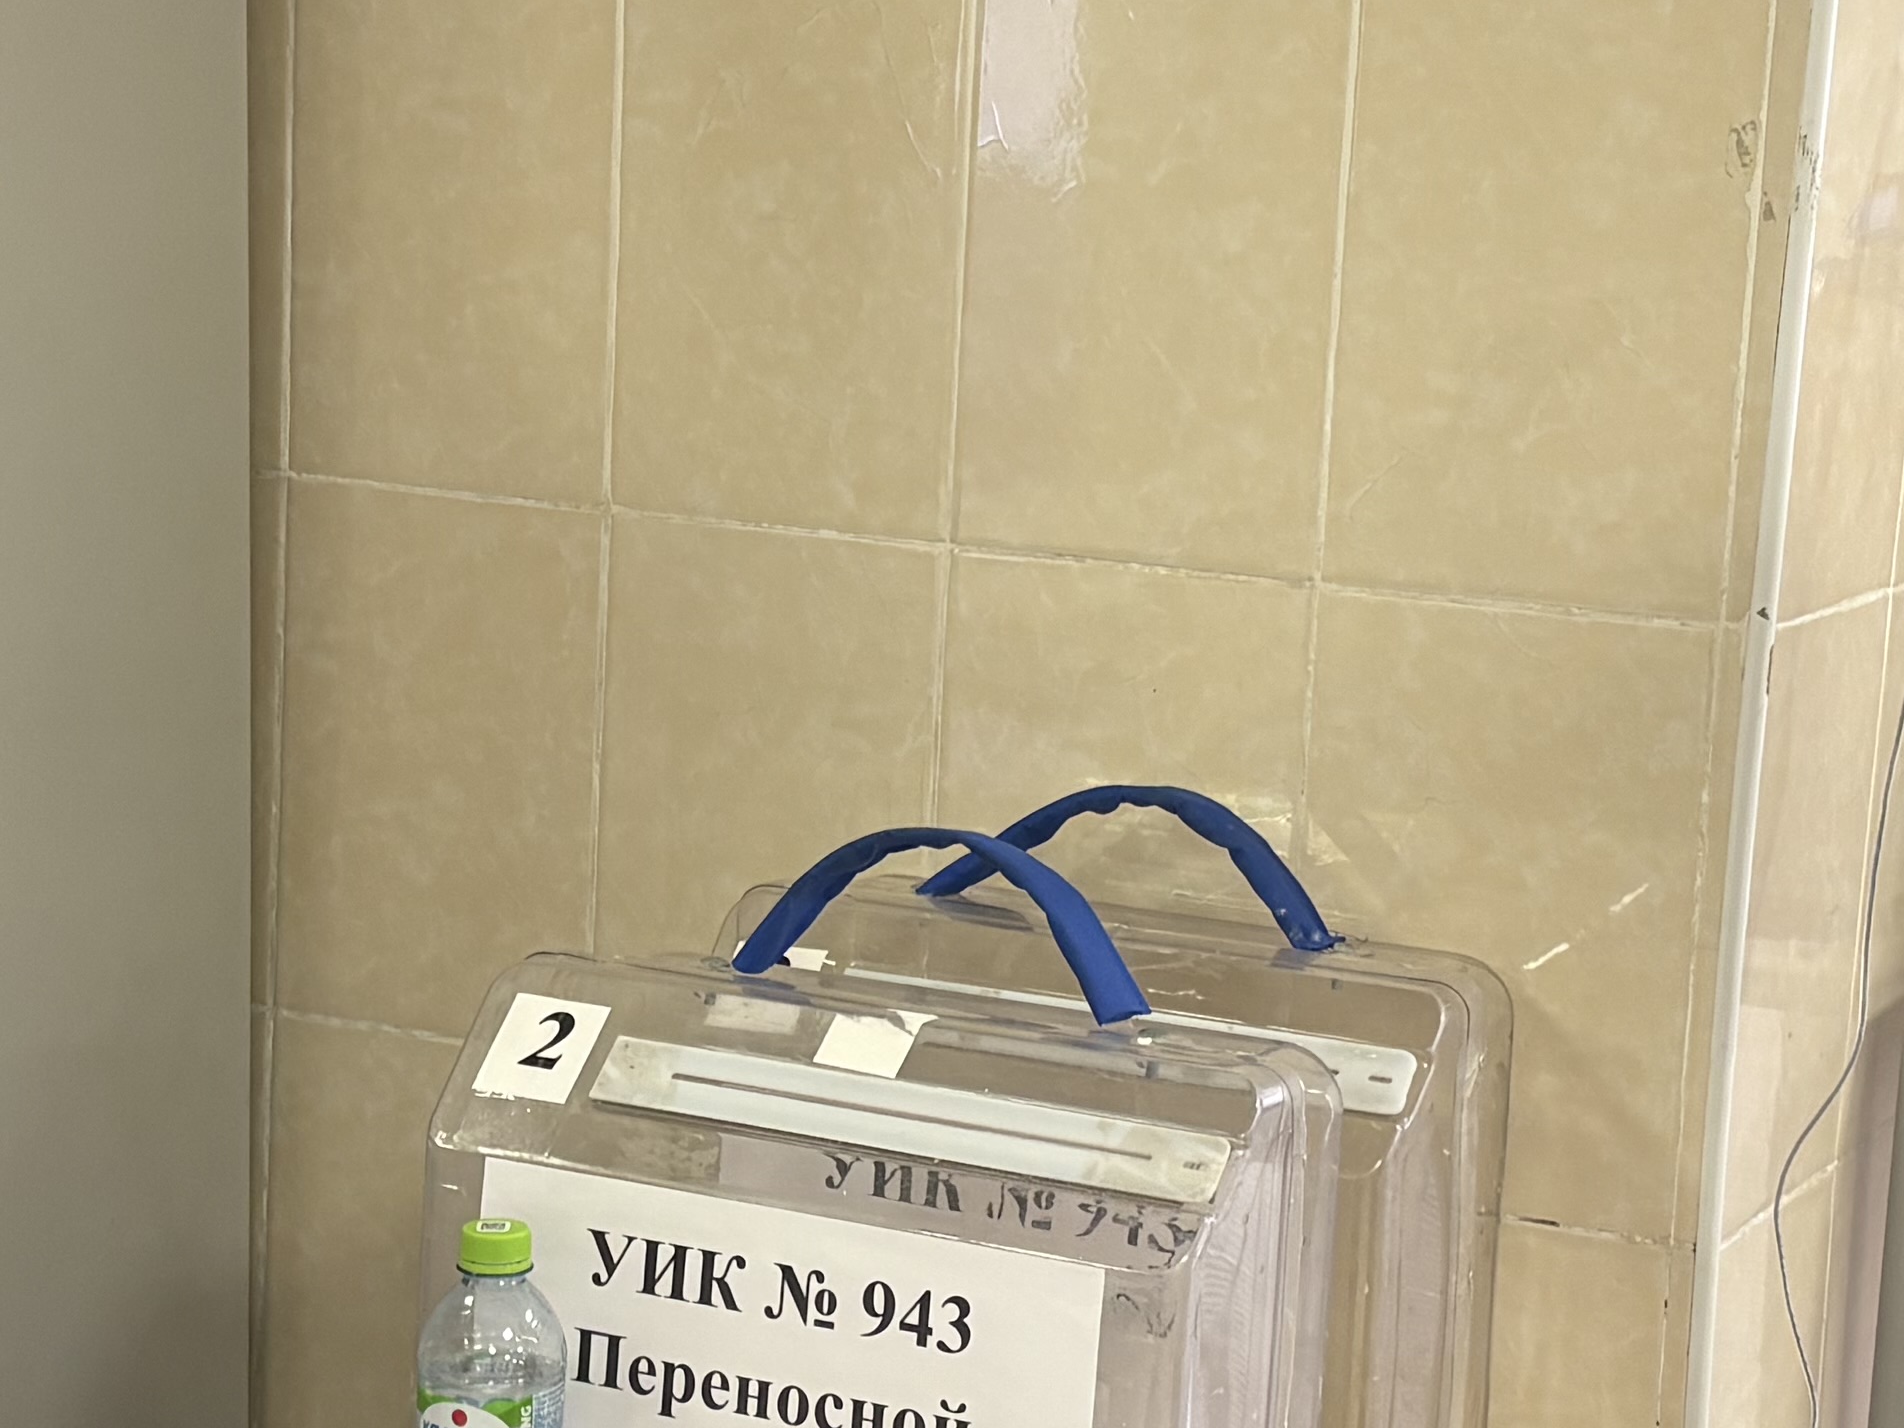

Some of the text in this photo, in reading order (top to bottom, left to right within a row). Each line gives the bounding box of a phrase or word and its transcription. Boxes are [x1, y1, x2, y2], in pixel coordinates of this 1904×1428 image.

[517, 1011, 576, 1071] 2
[823, 1151, 963, 1213] УИК
[587, 1227, 972, 1355] УИК № 943
